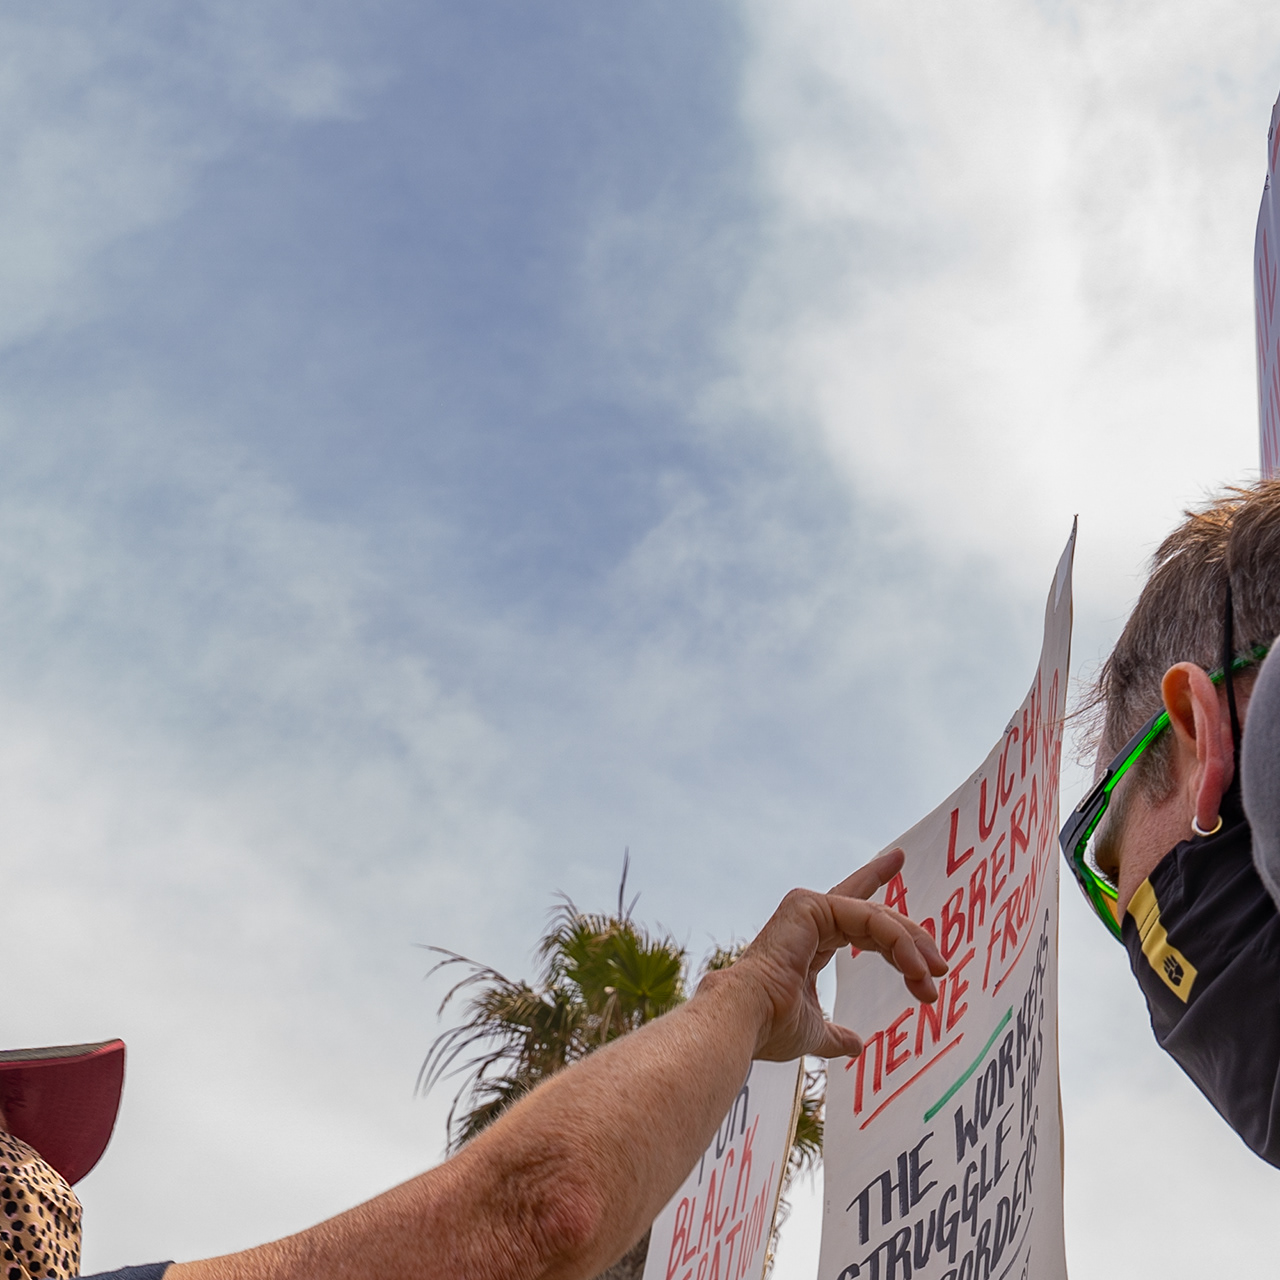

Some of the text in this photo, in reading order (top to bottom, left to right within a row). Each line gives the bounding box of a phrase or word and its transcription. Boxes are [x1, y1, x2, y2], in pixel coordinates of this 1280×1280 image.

[946, 667, 1042, 878] LUCHA
[845, 946, 976, 1117] TIENE
[846, 907, 1050, 1245] THE WORKERS
[1020, 998, 1045, 1141] HAS
